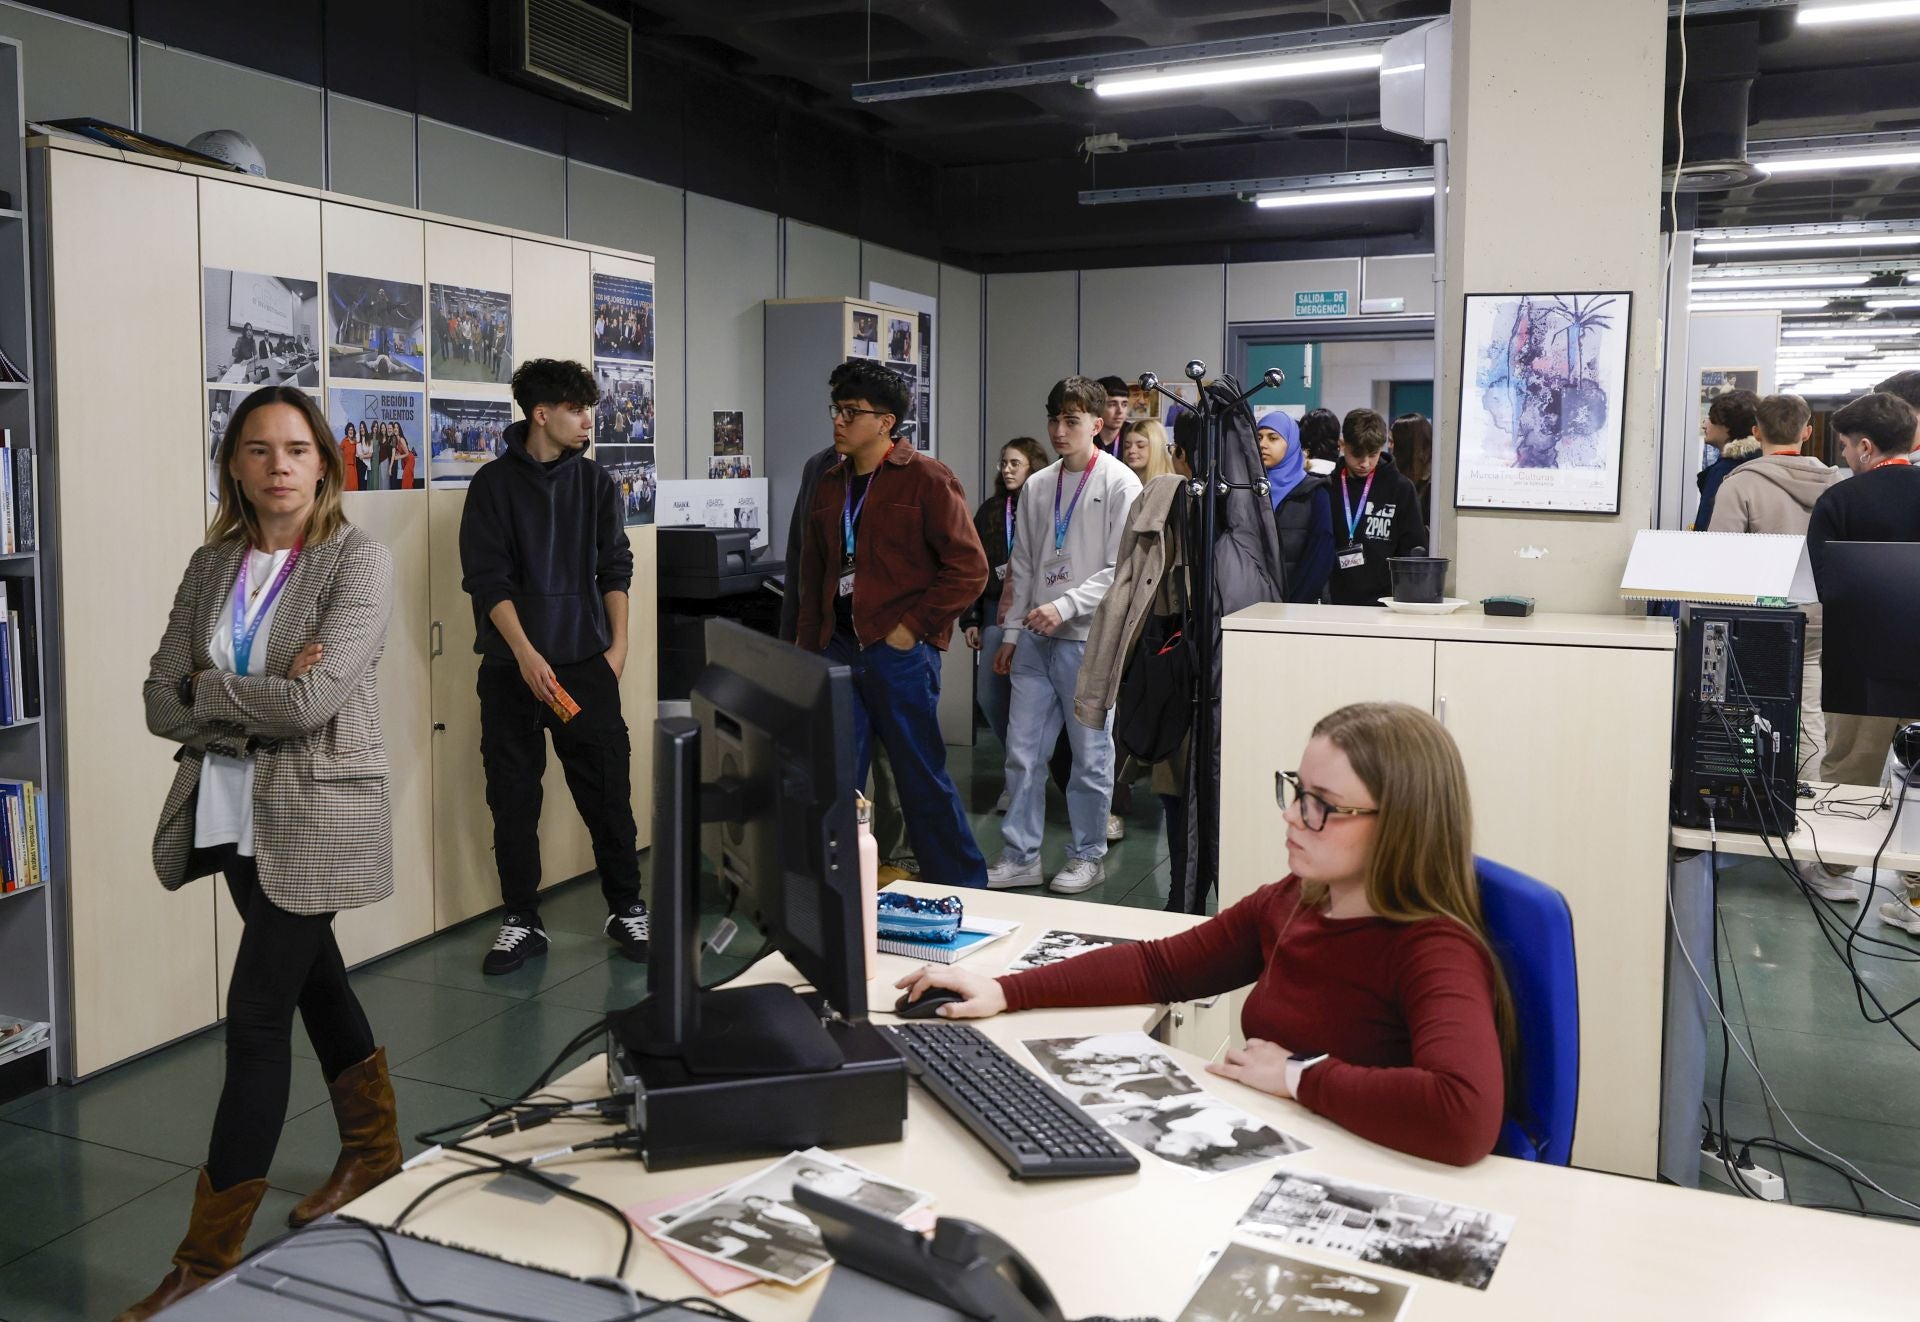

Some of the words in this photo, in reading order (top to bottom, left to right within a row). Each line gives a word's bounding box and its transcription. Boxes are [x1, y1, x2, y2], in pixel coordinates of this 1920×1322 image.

[604, 294, 626, 305] MEJORES
[626, 297, 633, 306] DE
[1298, 293, 1325, 304] SALIDA
[1333, 292, 1344, 303] DE
[1296, 304, 1346, 315] EMERGENCIA
[381, 394, 408, 407] REGIÓN
[409, 396, 415, 408] D
[381, 409, 414, 421] TALENTOS
[1365, 516, 1391, 538] 2PAC
